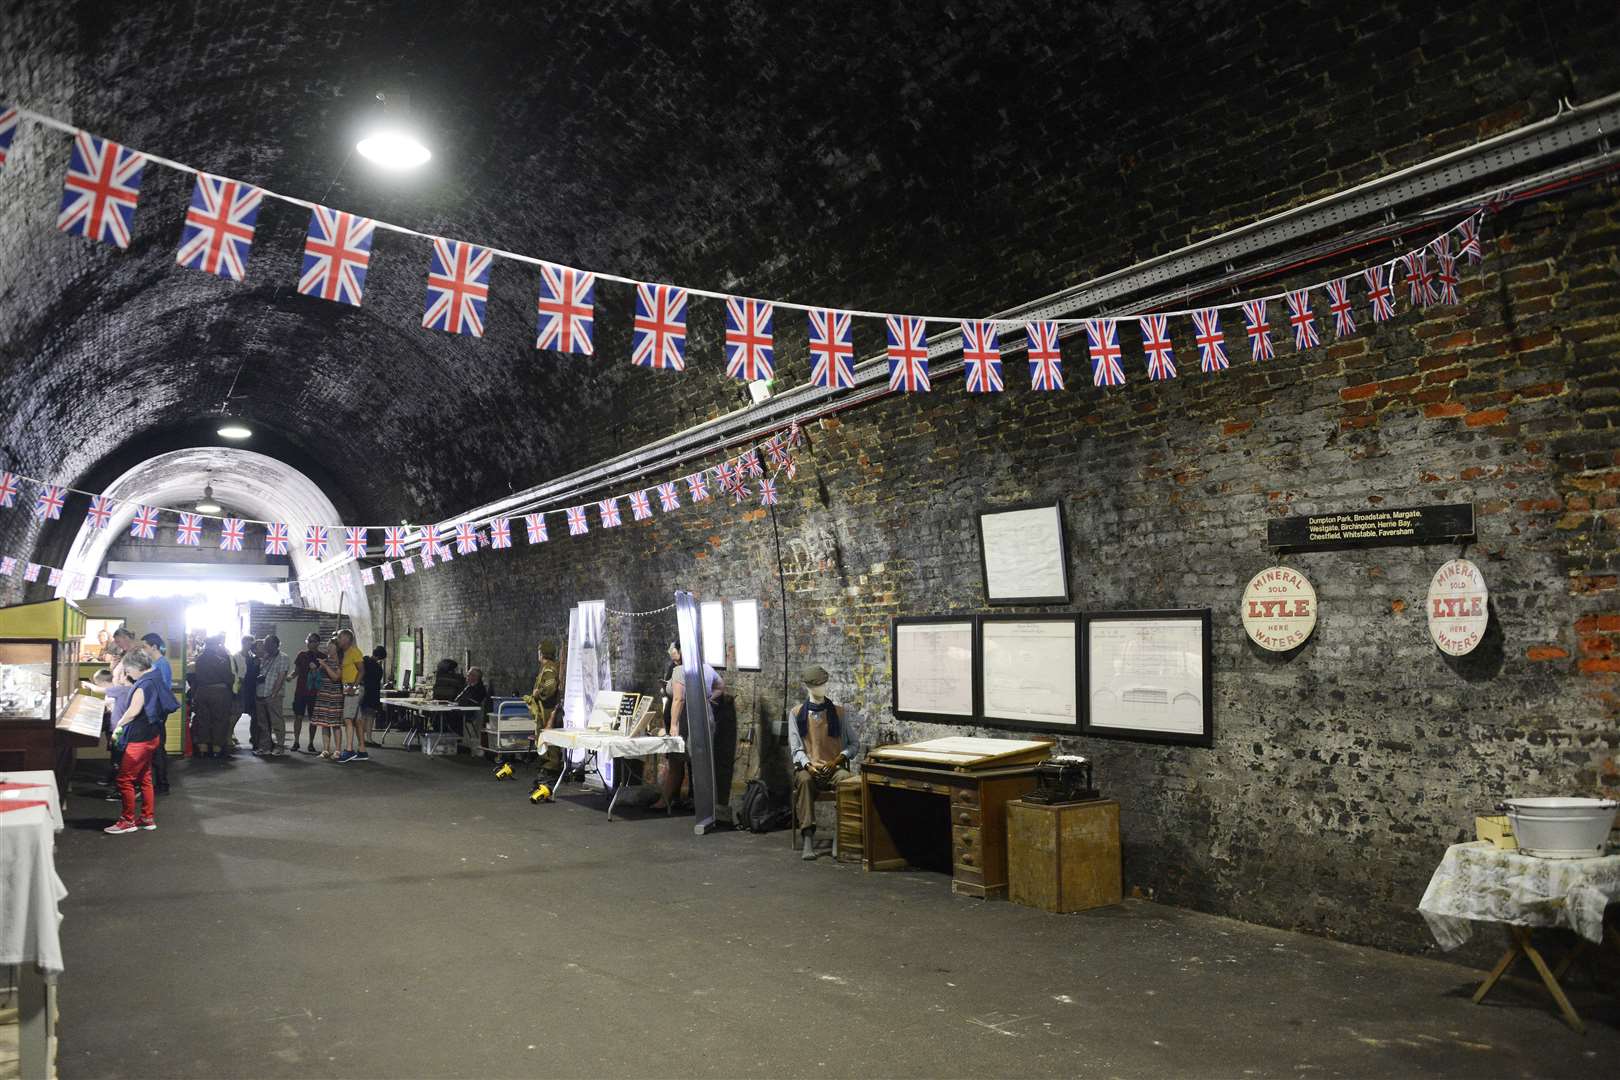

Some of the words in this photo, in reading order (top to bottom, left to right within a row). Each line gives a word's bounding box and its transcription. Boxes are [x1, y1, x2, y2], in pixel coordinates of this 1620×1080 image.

[1309, 517, 1336, 525] Dumpton
[1354, 513, 1391, 521] Broadstairs,
[1393, 510, 1422, 519] Margate,
[1309, 533, 1342, 541] Chestfield,
[1379, 528, 1414, 537] Faversham
[1310, 525, 1340, 533] Westgate,
[1341, 523, 1376, 531] Birchington,
[1253, 571, 1303, 591] MINERAL
[1437, 564, 1477, 587] MINERAL
[1248, 600, 1310, 618] LYLE
[1432, 597, 1483, 617] LYLE
[1255, 629, 1304, 647] WATERS
[1449, 625, 1467, 633] HERE
[1438, 631, 1478, 651] WATERS
